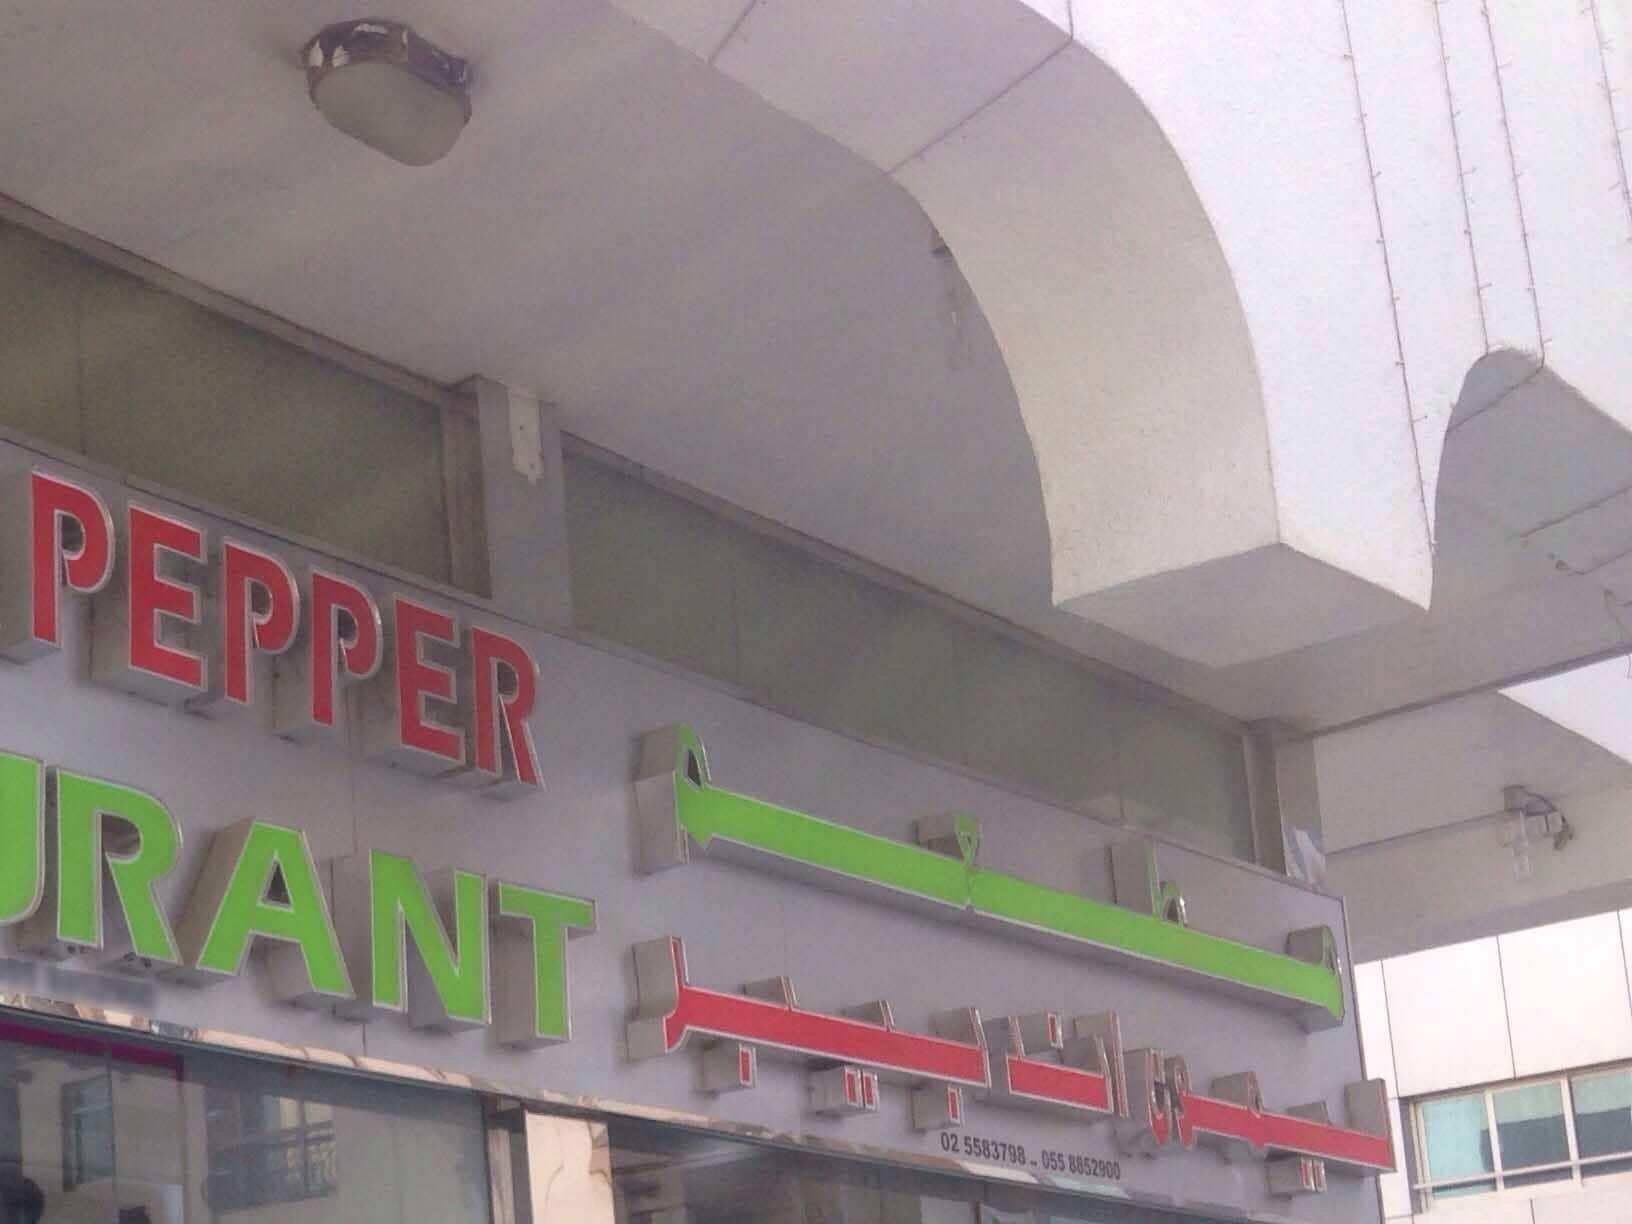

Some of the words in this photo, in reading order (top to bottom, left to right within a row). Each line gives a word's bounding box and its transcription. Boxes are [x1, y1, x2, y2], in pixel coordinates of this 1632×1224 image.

[30, 467, 545, 790] PEPPER
[941, 1132, 960, 1153] 02
[964, 1136, 1027, 1167] 5583798
[1042, 1150, 1066, 1172] 055
[1069, 1156, 1122, 1181] 8852900
